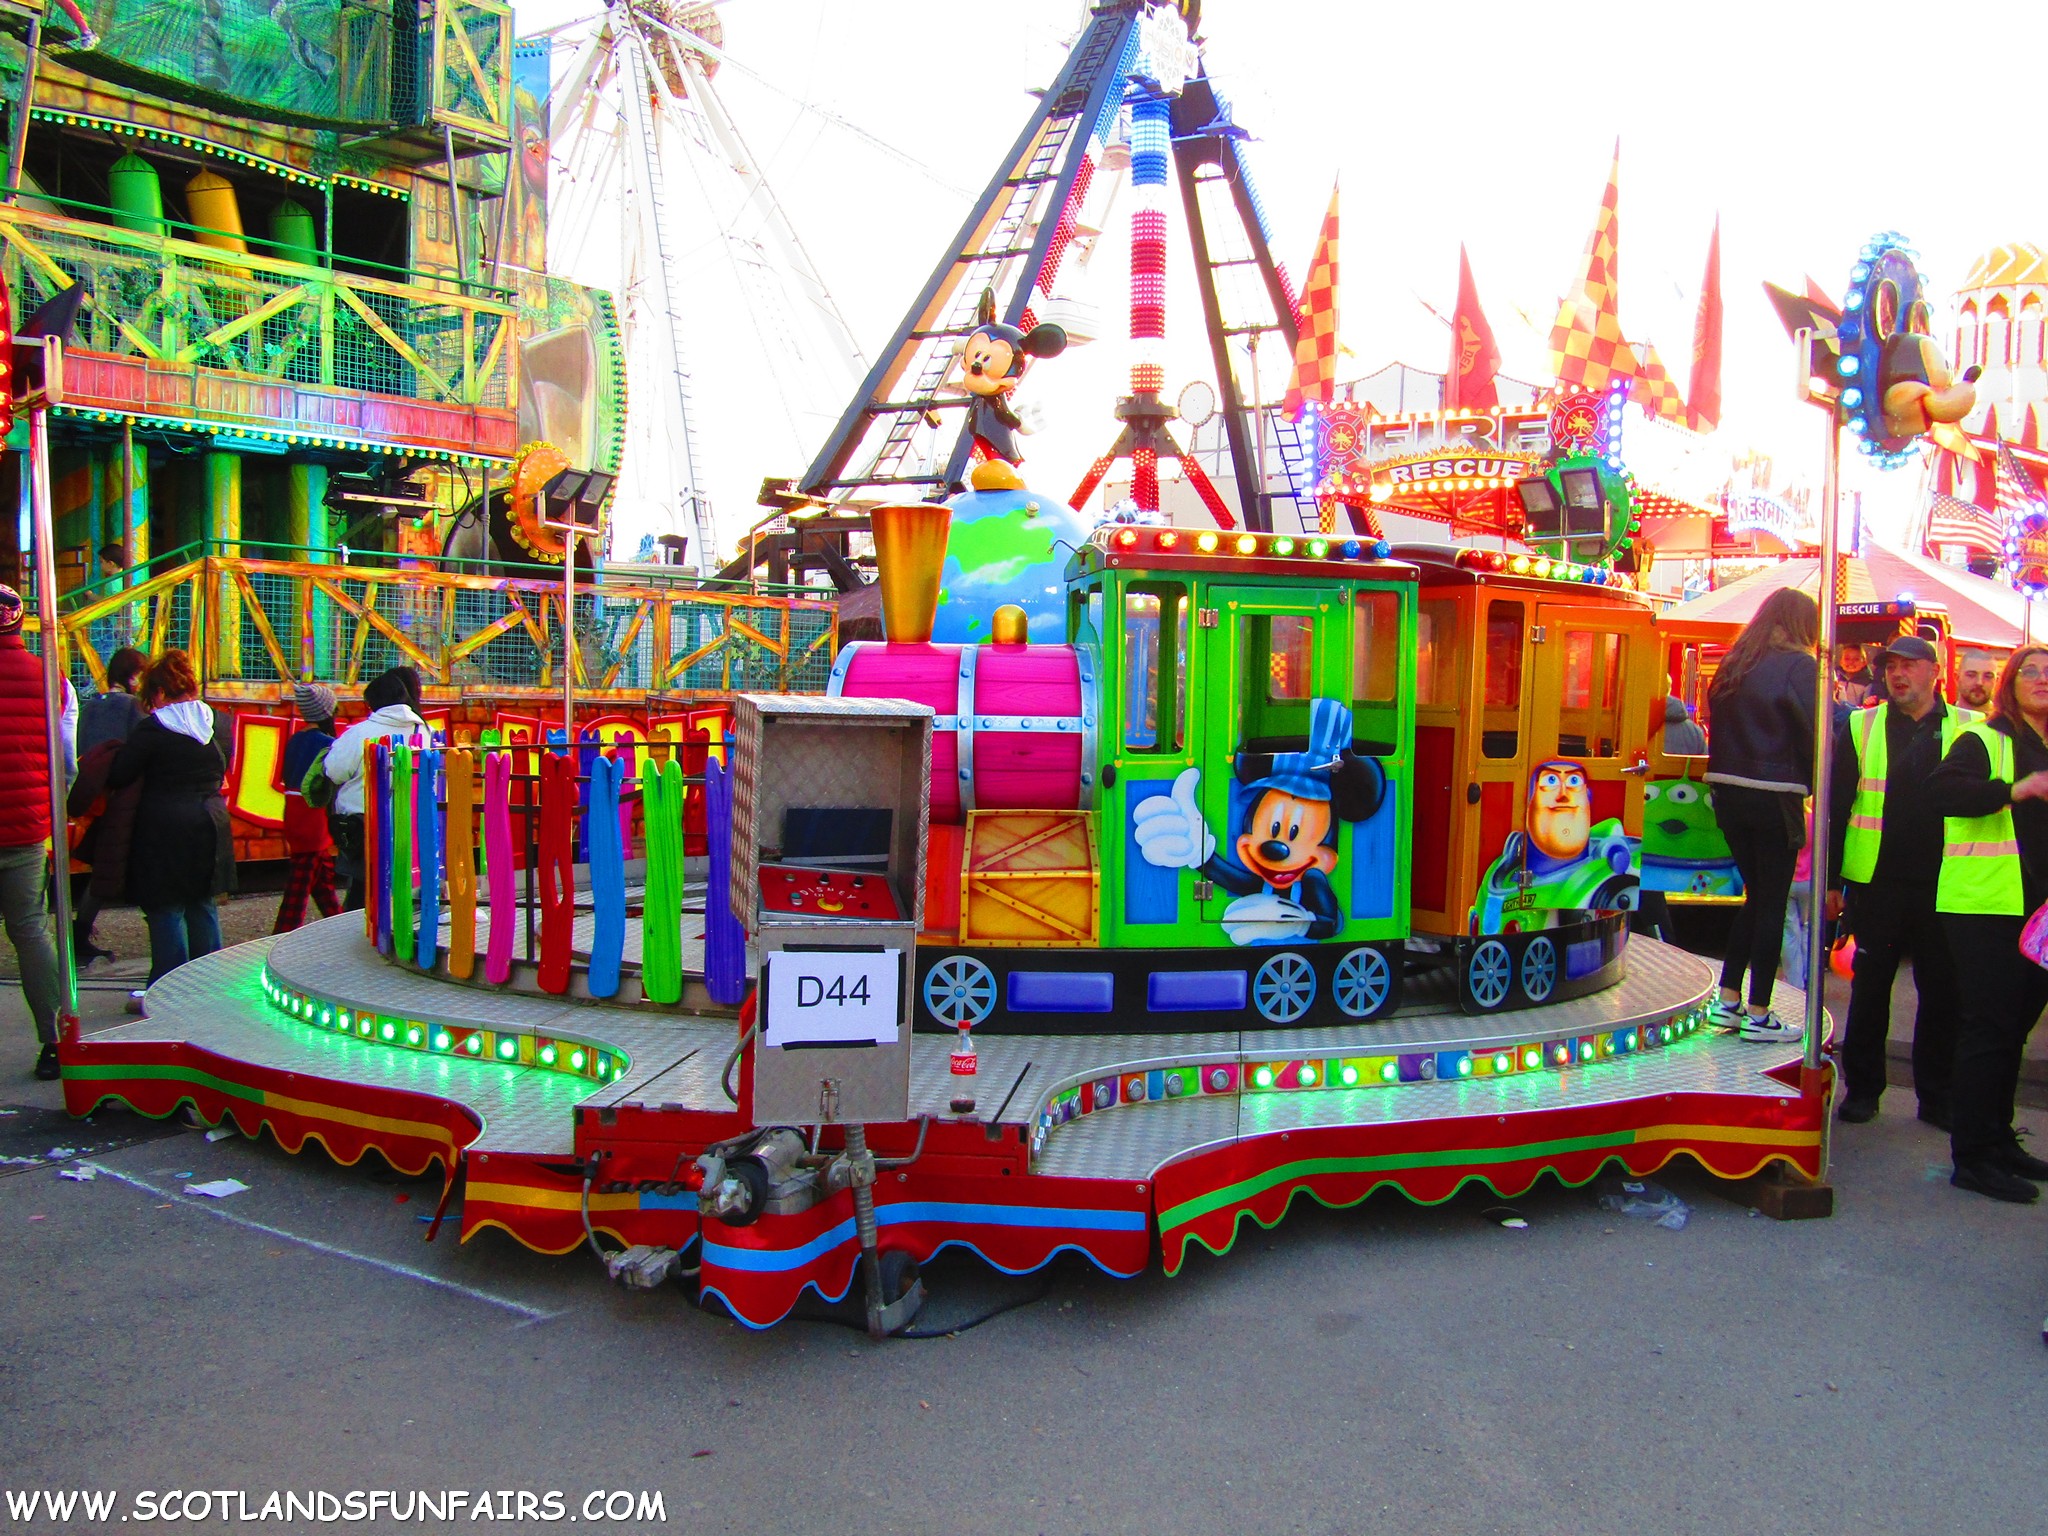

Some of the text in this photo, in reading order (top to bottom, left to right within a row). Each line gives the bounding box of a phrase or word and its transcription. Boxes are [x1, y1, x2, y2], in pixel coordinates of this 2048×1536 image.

[1367, 412, 1551, 461] FIRE
[1389, 459, 1524, 484] RESCUE
[2018, 537, 2048, 555] FIR
[1839, 604, 1880, 615] RESCUE
[797, 974, 871, 1008] D44
